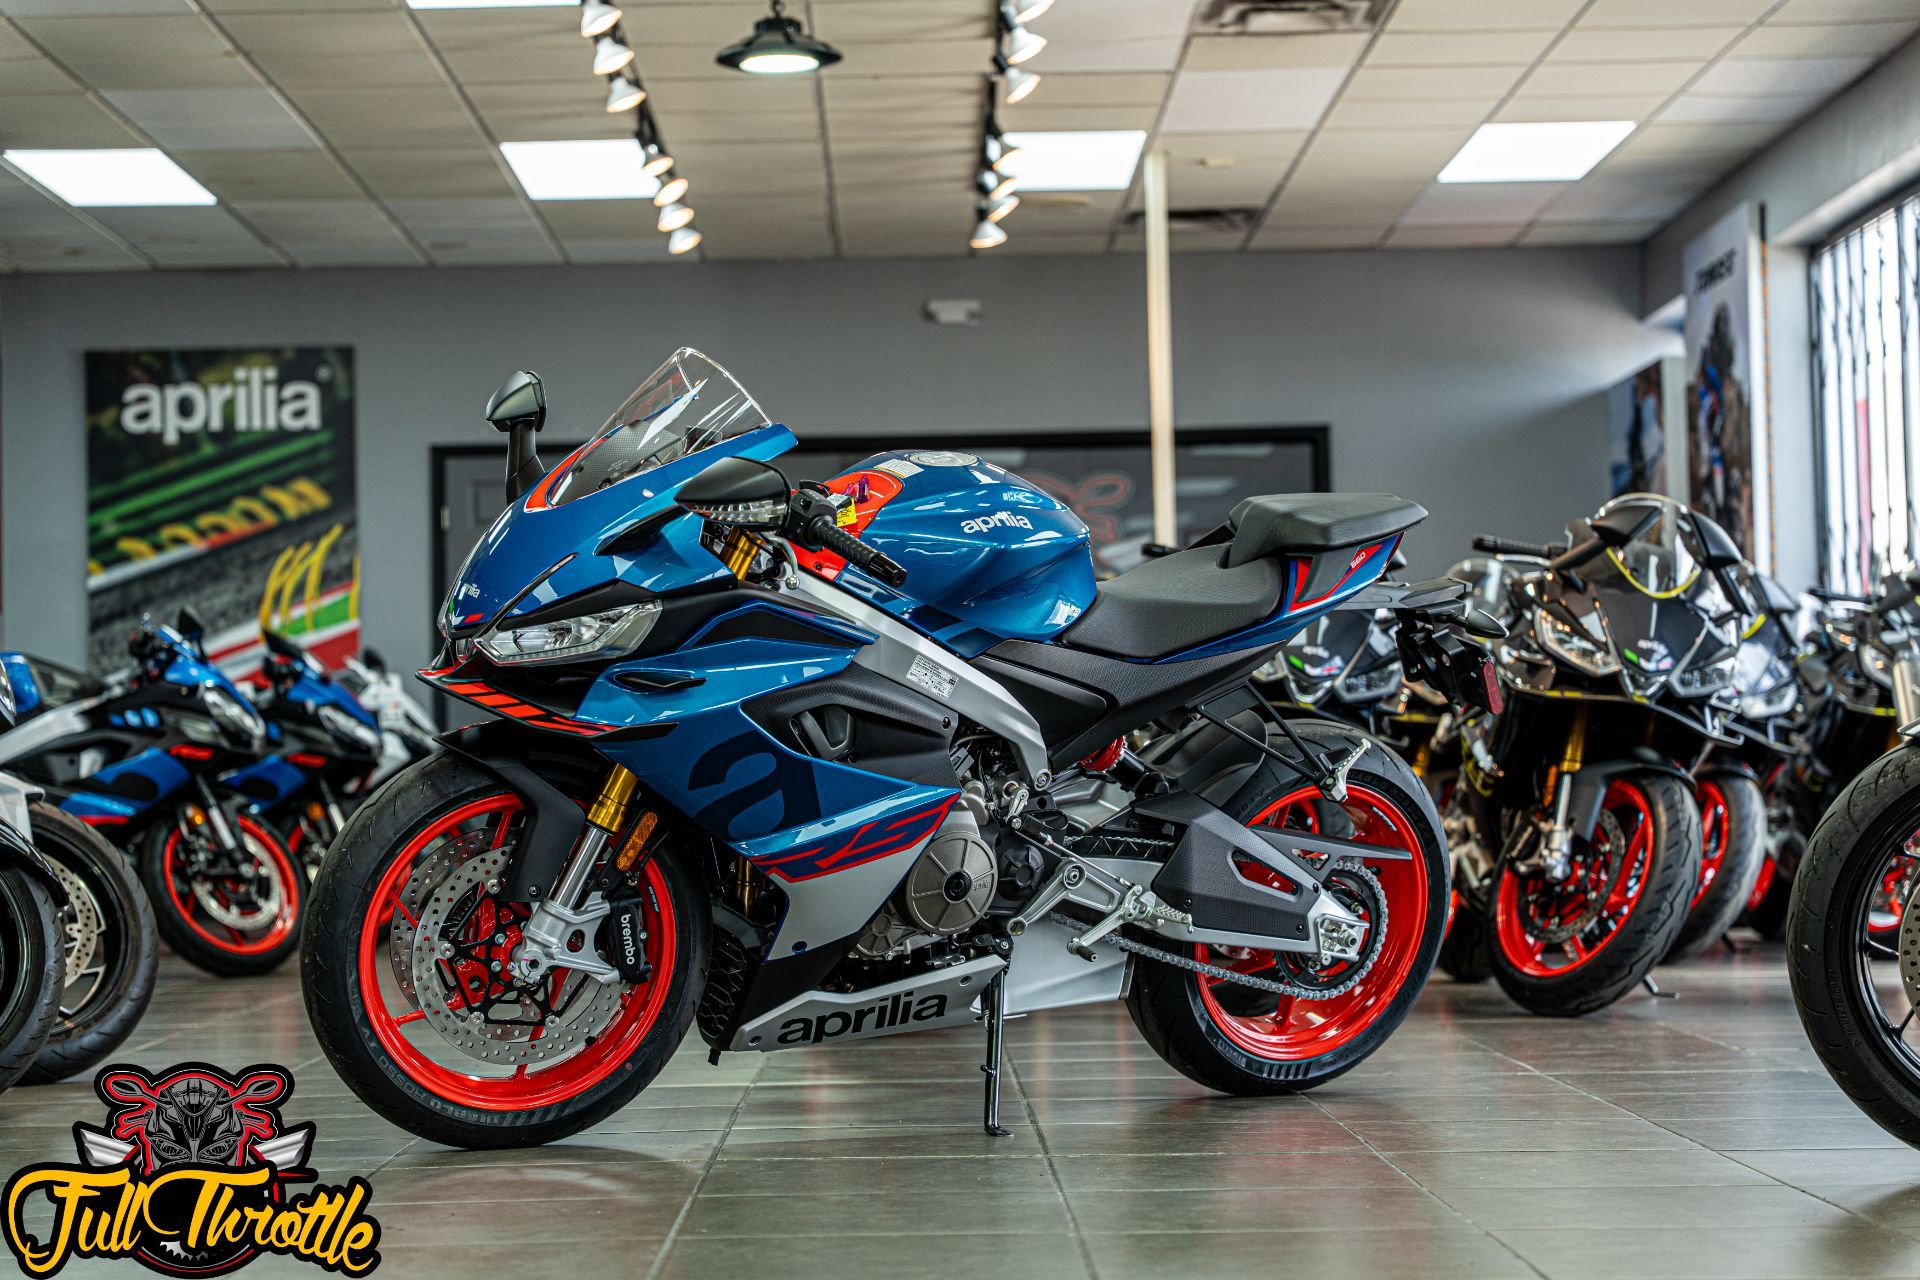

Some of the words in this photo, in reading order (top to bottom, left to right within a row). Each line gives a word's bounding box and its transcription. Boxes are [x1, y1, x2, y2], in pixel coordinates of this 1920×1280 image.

[120, 366, 322, 446] aprilia
[960, 511, 1034, 533] aprilia
[620, 913, 636, 965] brembo
[776, 990, 949, 1045] aprilia
[378, 1054, 428, 1102] ROSSO
